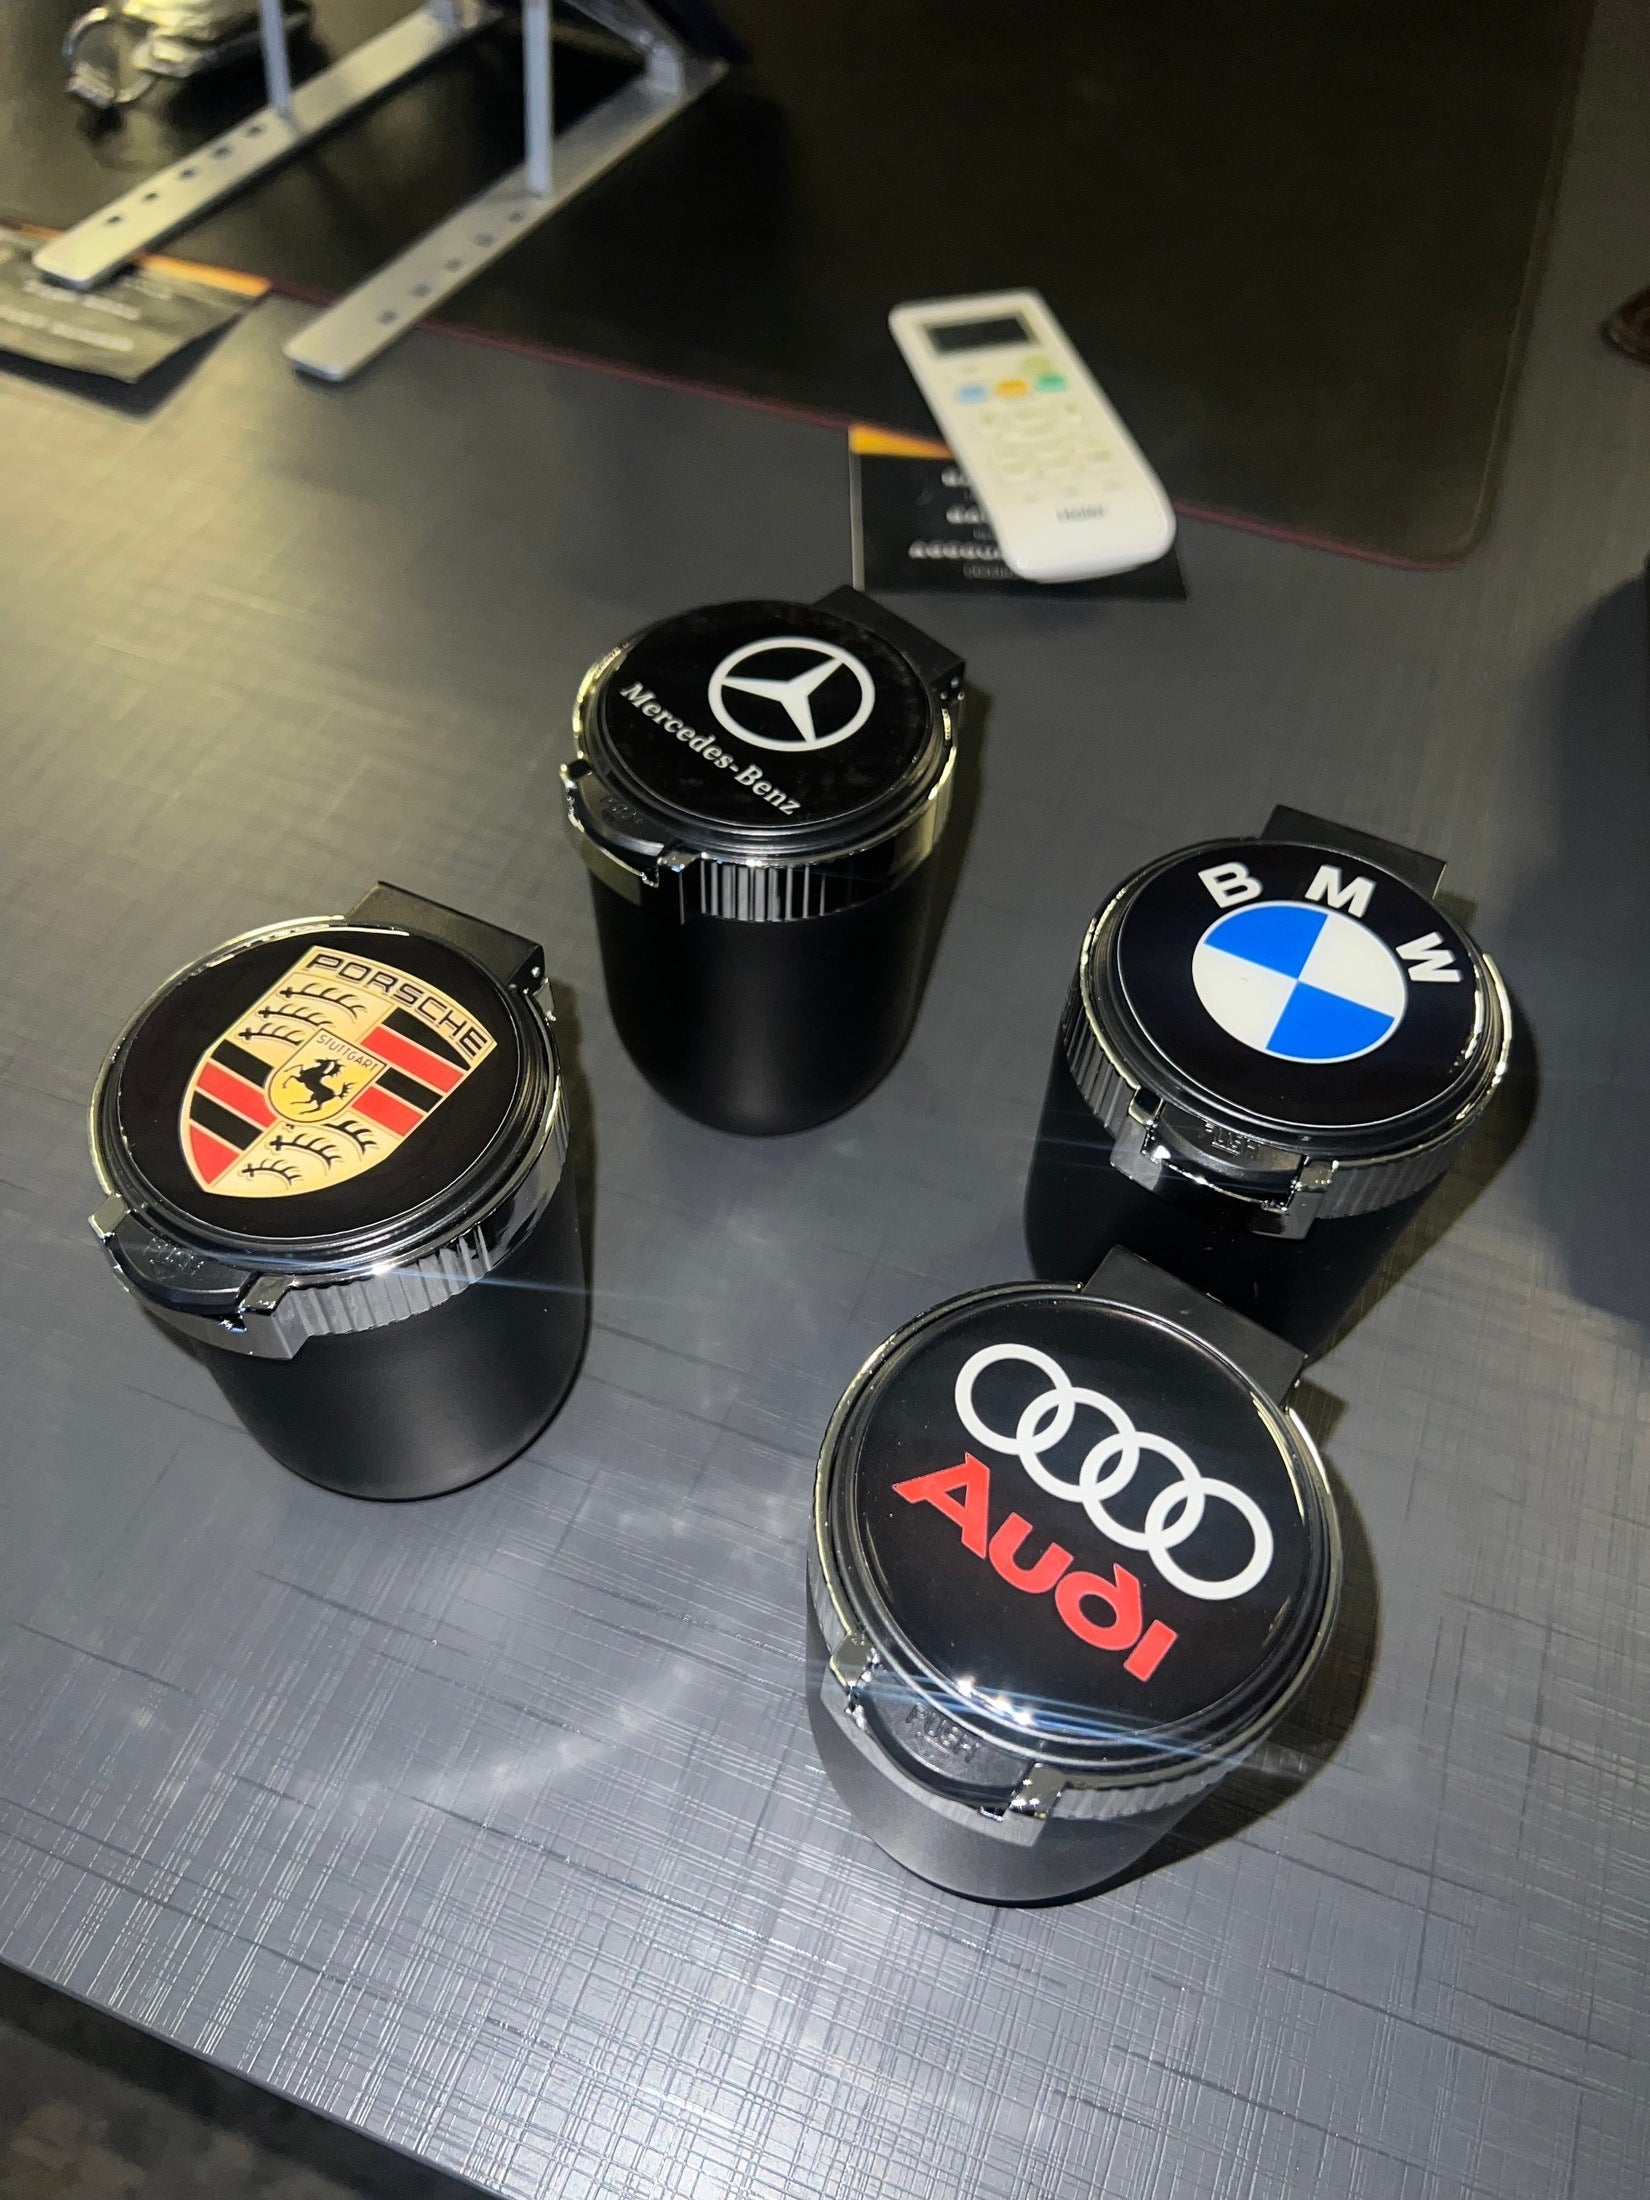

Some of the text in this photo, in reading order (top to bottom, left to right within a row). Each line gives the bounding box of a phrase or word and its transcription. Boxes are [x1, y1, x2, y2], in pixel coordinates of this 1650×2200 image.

[619, 681, 802, 816] Mercedes-Benz
[1198, 861, 1462, 985] BMW
[306, 954, 488, 1057] PORSCHE
[316, 1034, 378, 1071] STUTTGART
[892, 1453, 1178, 1683] Audi
[906, 1702, 981, 1763] PUSH
